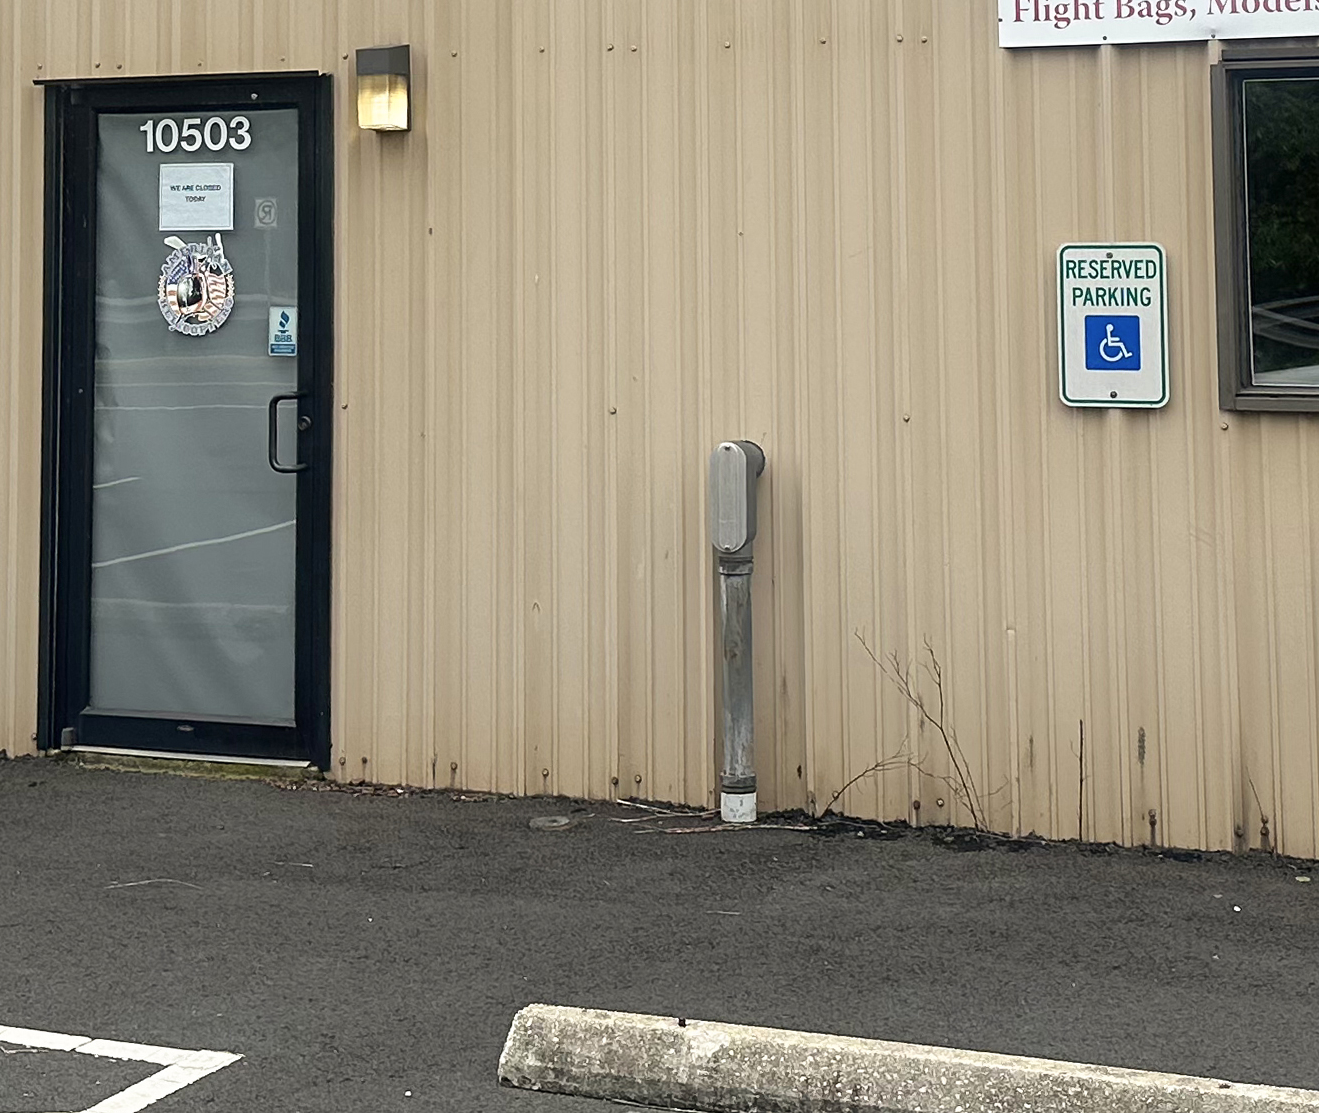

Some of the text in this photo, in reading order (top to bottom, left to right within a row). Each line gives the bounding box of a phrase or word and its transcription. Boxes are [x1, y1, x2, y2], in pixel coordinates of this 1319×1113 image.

[139, 116, 252, 153] 10503
[1065, 259, 1157, 280] RESERVED
[1072, 287, 1152, 307] PARKING
